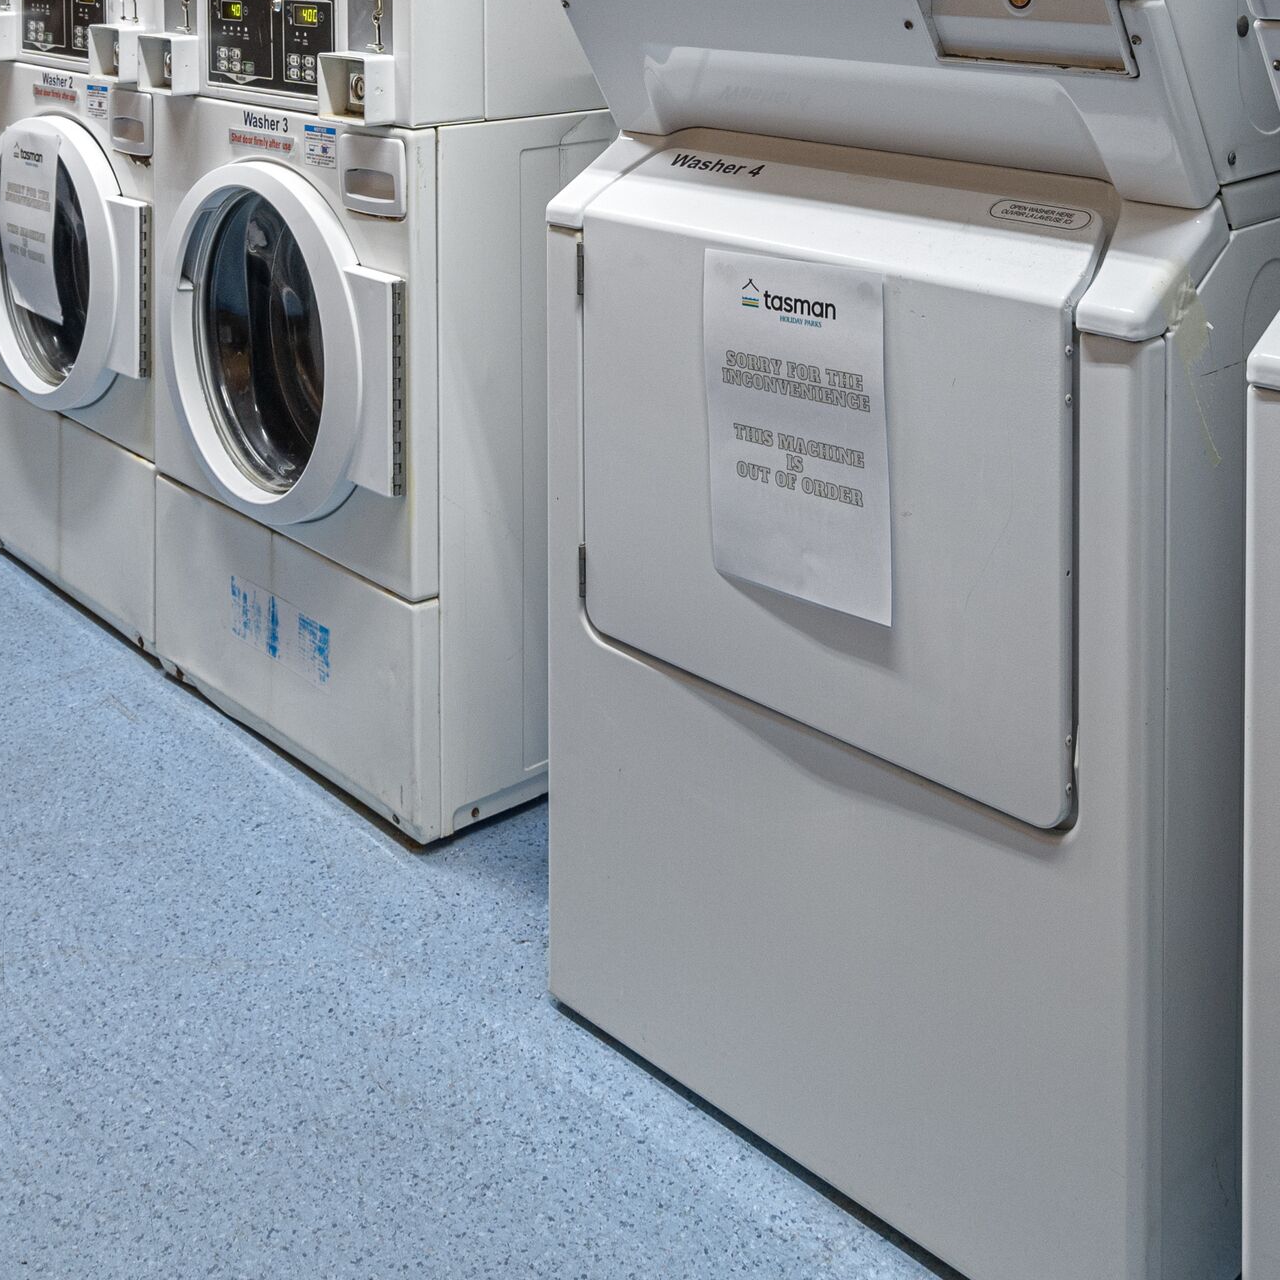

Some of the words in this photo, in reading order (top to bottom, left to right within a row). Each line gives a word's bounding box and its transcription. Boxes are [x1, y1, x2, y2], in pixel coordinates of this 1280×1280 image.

[231, 4, 241, 16] 40
[42, 72, 68, 87] Washer
[69, 76, 73, 89] 2
[243, 110, 280, 131] Washer
[282, 117, 289, 133] 3
[231, 132, 242, 142] Shut
[242, 134, 254, 144] door
[253, 135, 269, 149] firmly
[269, 139, 281, 149] after
[20, 148, 43, 163] tasman
[670, 153, 747, 175] Washer
[748, 164, 766, 177] 4
[1028, 206, 1056, 215] WASHER
[763, 290, 836, 320] tasman
[779, 315, 803, 326] HOLIDAY
[804, 319, 822, 328] PARKS
[725, 349, 782, 376] SORRY
[786, 361, 821, 383] FOR
[825, 369, 863, 392] THE
[722, 367, 871, 412] INCONVENIENCE
[733, 422, 774, 447] THIS
[778, 433, 865, 469] MACHINE
[786, 454, 804, 473] IS
[736, 460, 771, 484] OUT
[775, 470, 797, 490] OF
[801, 477, 864, 508] ORDER
